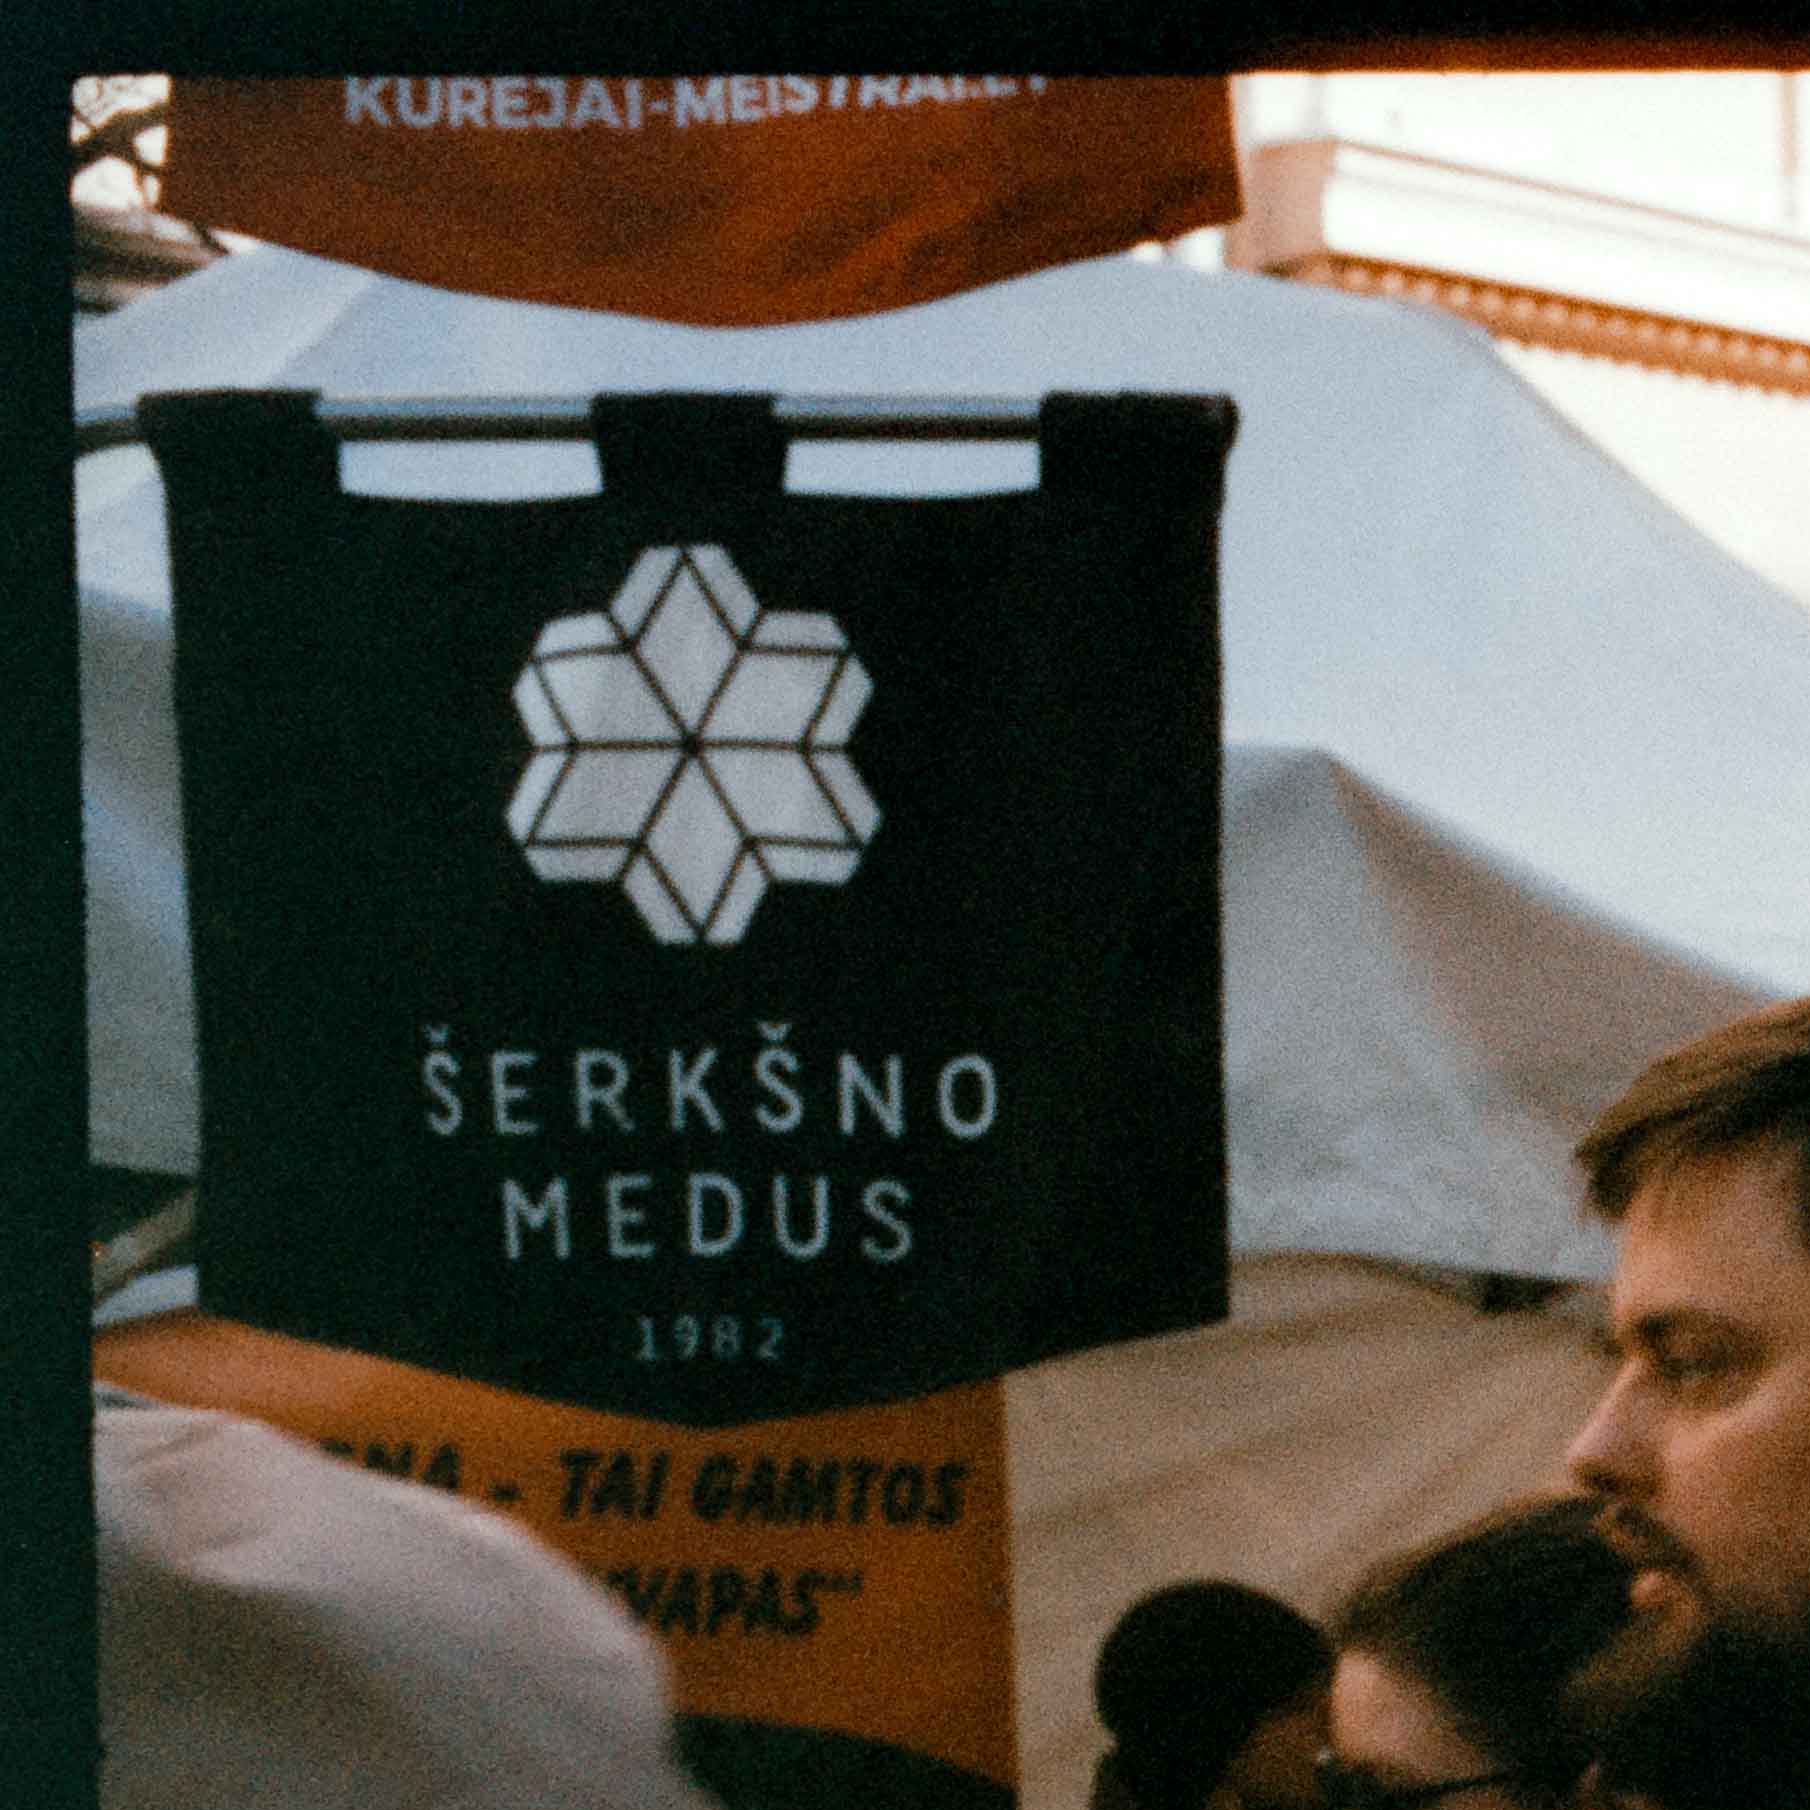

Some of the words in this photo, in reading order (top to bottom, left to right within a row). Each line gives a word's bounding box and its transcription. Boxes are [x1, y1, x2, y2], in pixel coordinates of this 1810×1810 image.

[421, 1022, 998, 1139] ŠERKŠNO
[502, 1174, 911, 1262] MEDUS
[637, 1315, 785, 1361] 1982
[559, 1448, 671, 1521] TAI
[691, 1451, 973, 1526] GAMTOS
